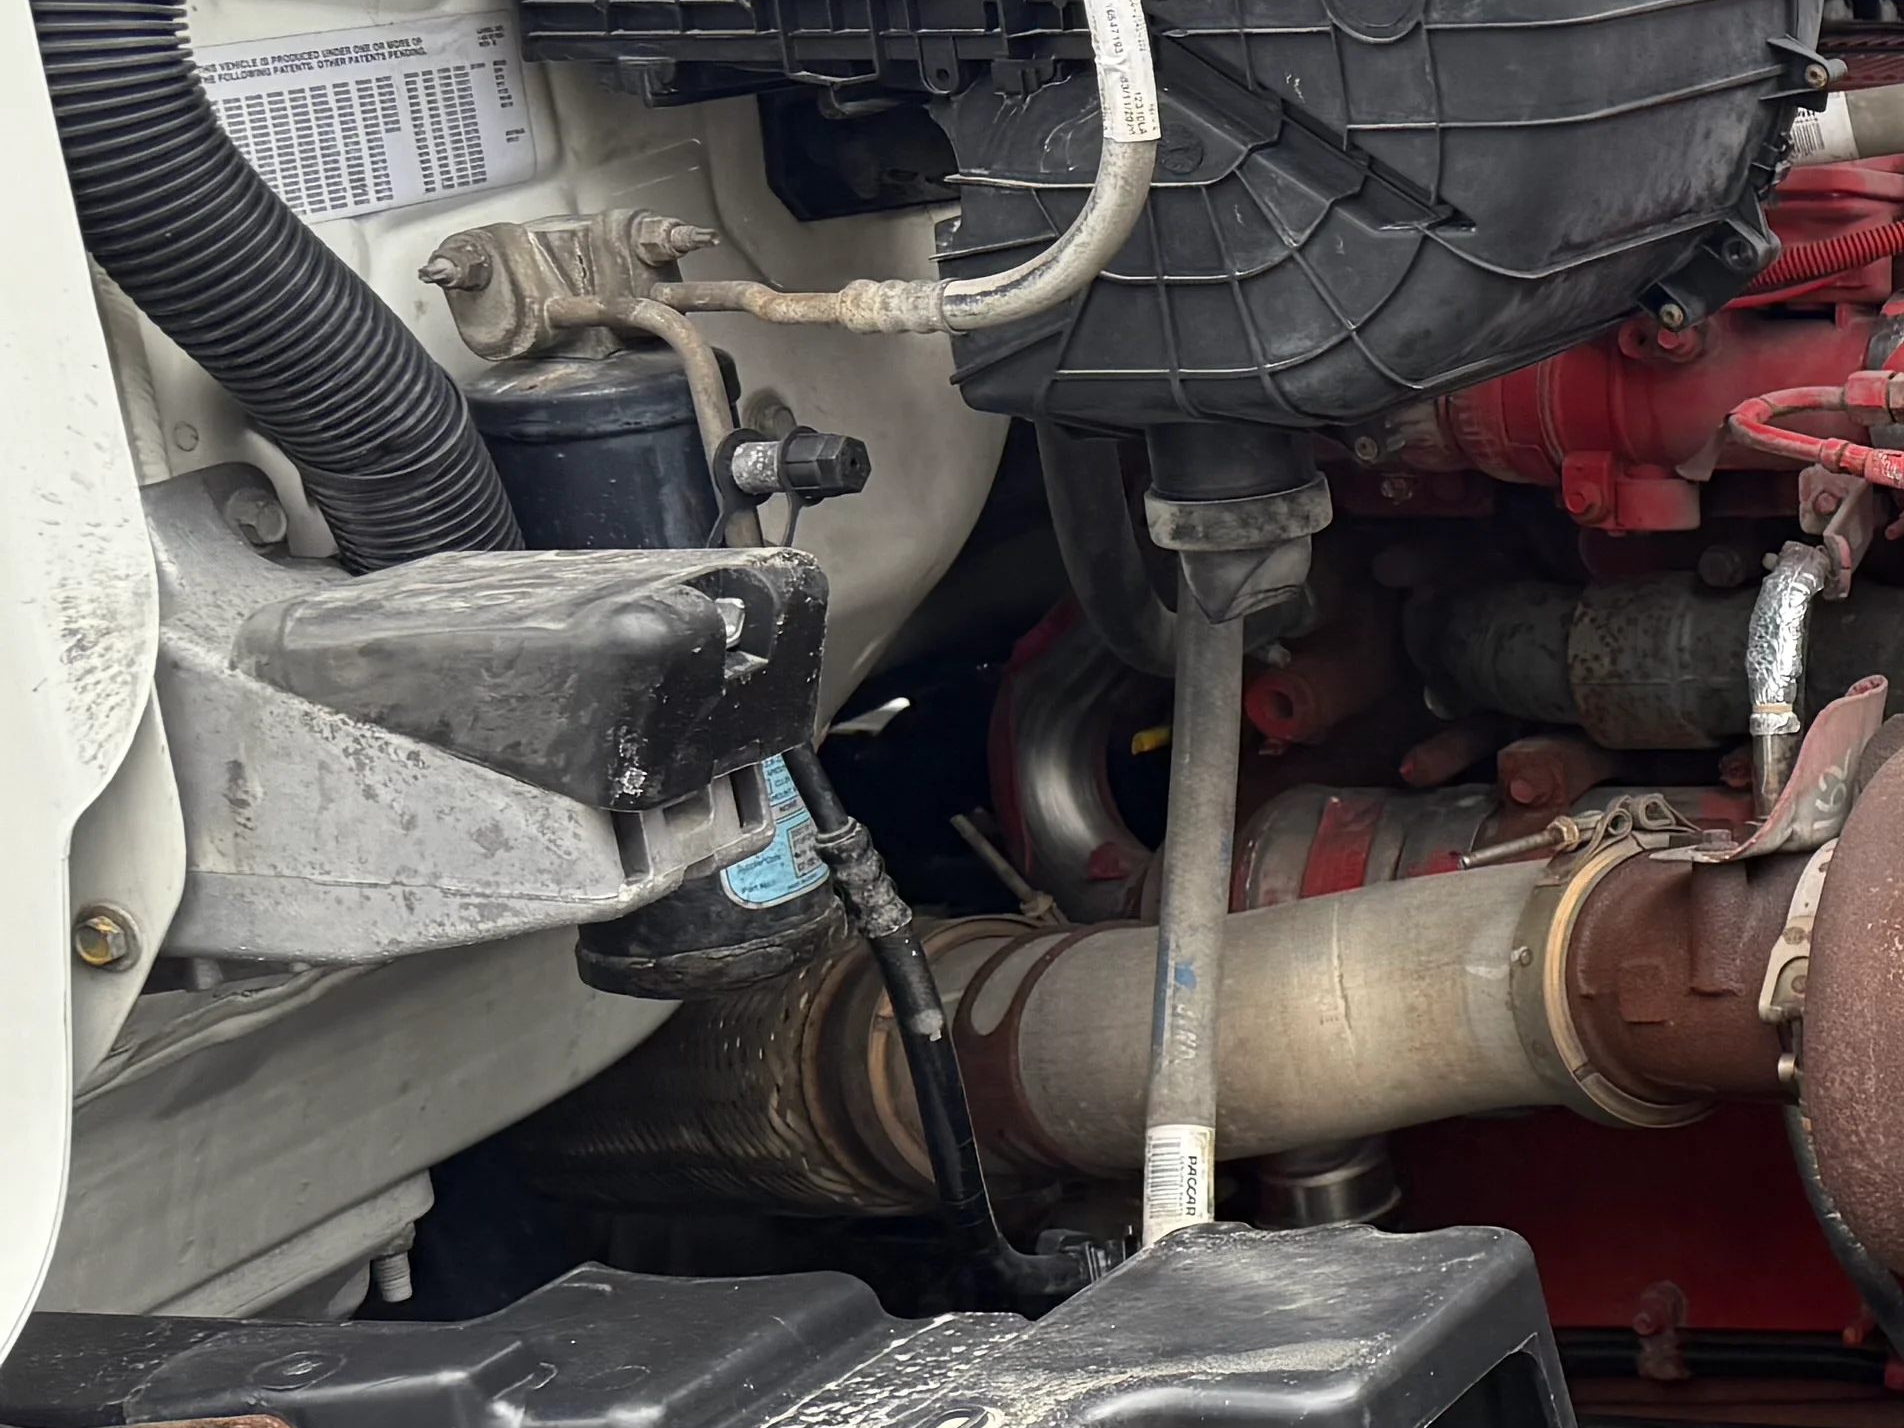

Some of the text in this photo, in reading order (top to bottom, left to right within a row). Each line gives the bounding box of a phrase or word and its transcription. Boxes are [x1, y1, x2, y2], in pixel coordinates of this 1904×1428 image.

[218, 68, 272, 82] FOLLOWING
[317, 57, 347, 69] OTHER
[348, 53, 387, 65] PATENTS
[219, 58, 258, 71] VEHICLE
[271, 51, 320, 66] PRODUCED
[322, 46, 352, 59] UNDER
[1185, 1155, 1198, 1216] PACCAR
